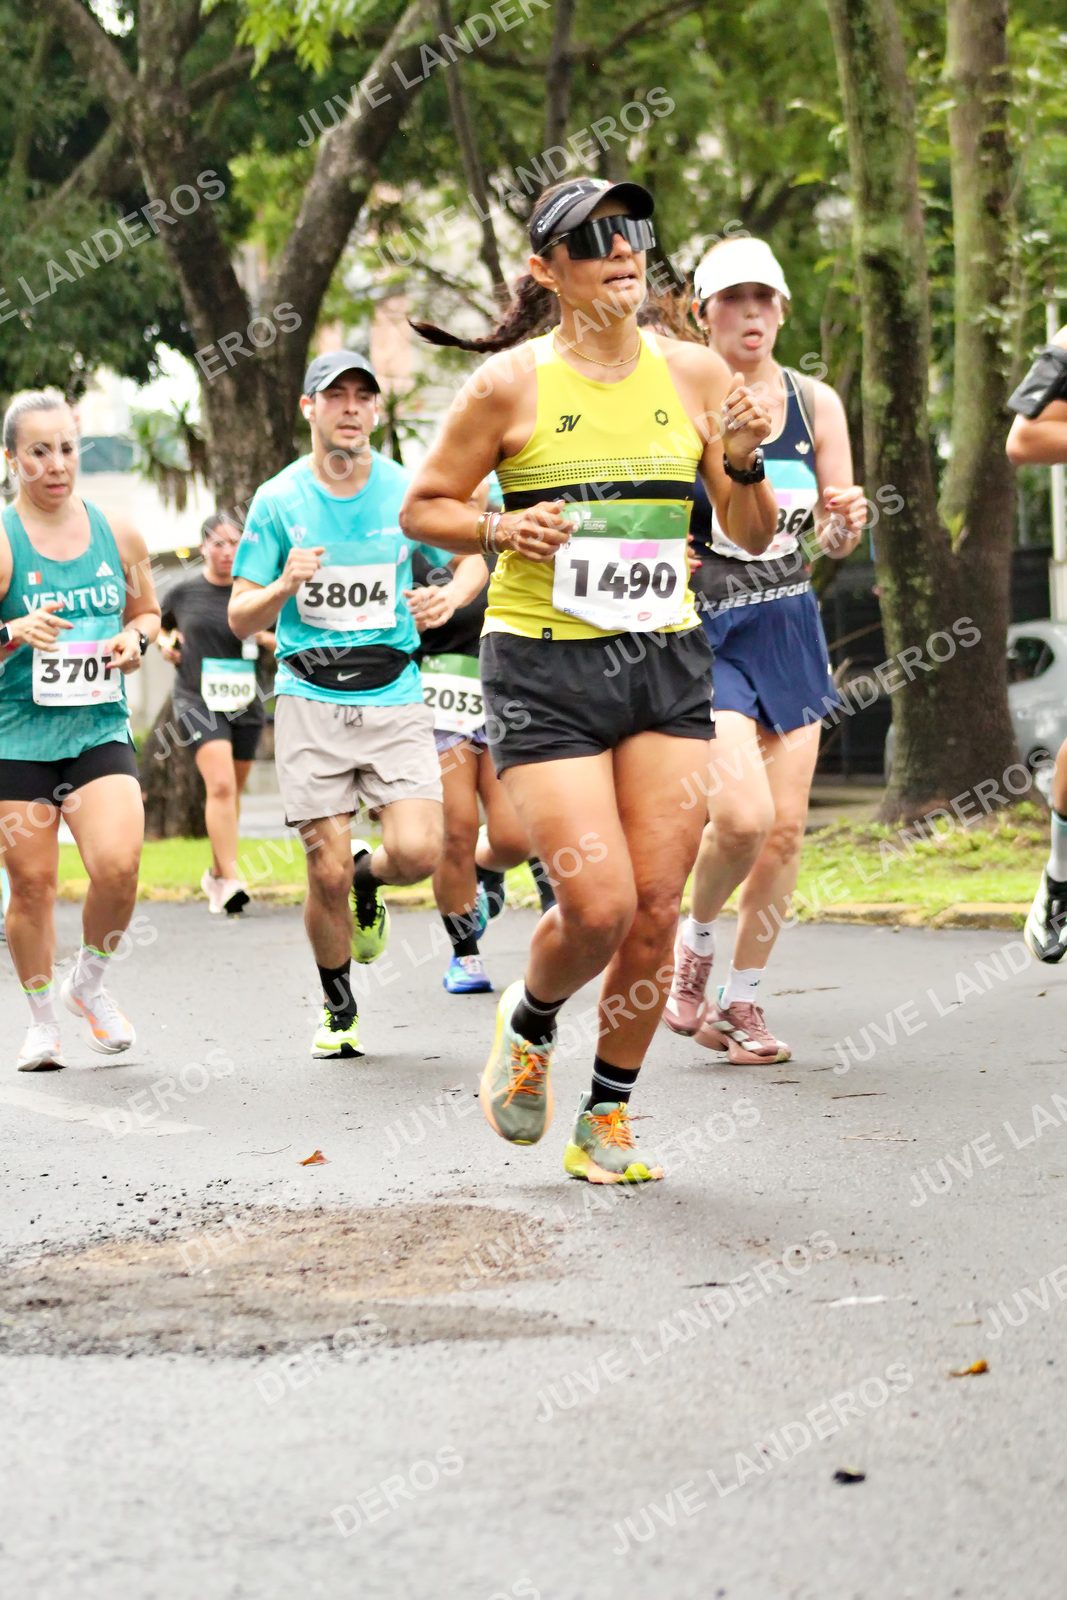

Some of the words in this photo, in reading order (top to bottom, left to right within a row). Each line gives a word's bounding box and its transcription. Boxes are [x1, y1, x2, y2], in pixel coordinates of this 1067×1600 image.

[556, 414, 581, 433] 3V
[570, 559, 677, 599] 1490
[22, 583, 119, 614] VENTUS
[304, 581, 388, 608] 3804
[694, 581, 811, 611] PRESSPORT
[423, 687, 483, 715] 2033
